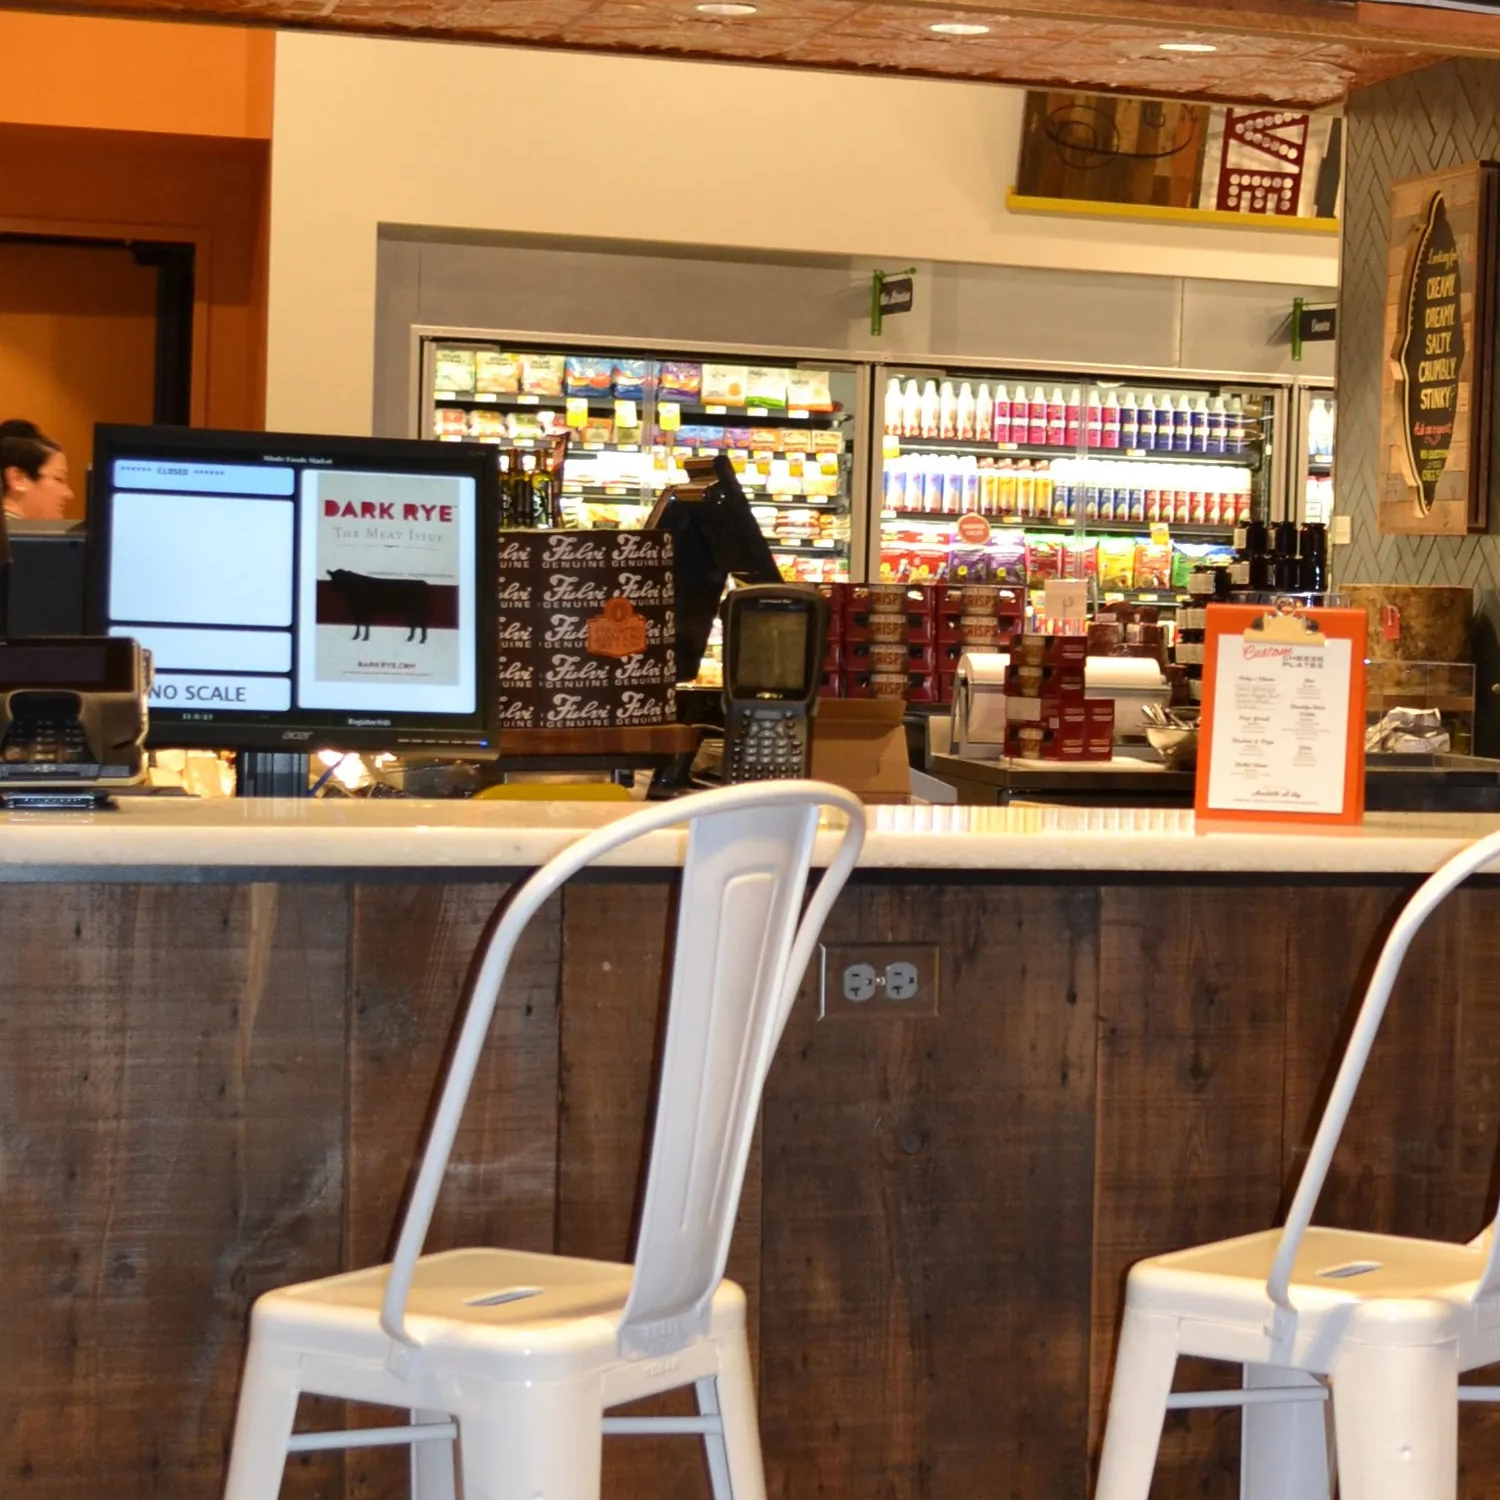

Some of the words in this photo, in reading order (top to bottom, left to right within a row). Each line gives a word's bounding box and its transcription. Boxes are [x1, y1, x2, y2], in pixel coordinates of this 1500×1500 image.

[157, 467, 189, 476] CLOSED
[324, 500, 395, 520] DARK
[403, 503, 453, 522] RYE
[542, 535, 606, 561] Fulvi
[611, 534, 660, 560] Fulvi
[543, 574, 607, 601] Fulvi
[612, 573, 660, 598] Fulvi
[543, 600, 606, 609] GENUINE
[1244, 645, 1292, 660] Custom
[546, 654, 609, 681] Fulvi
[615, 653, 662, 679] Fulvi
[546, 680, 609, 688] GENUINE
[149, 684, 178, 700] NO
[185, 685, 247, 703] SCALE
[547, 693, 611, 720] Fulvi
[616, 691, 663, 718] Fulvi
[547, 719, 610, 728] GENUINE
[282, 730, 313, 741] acer
